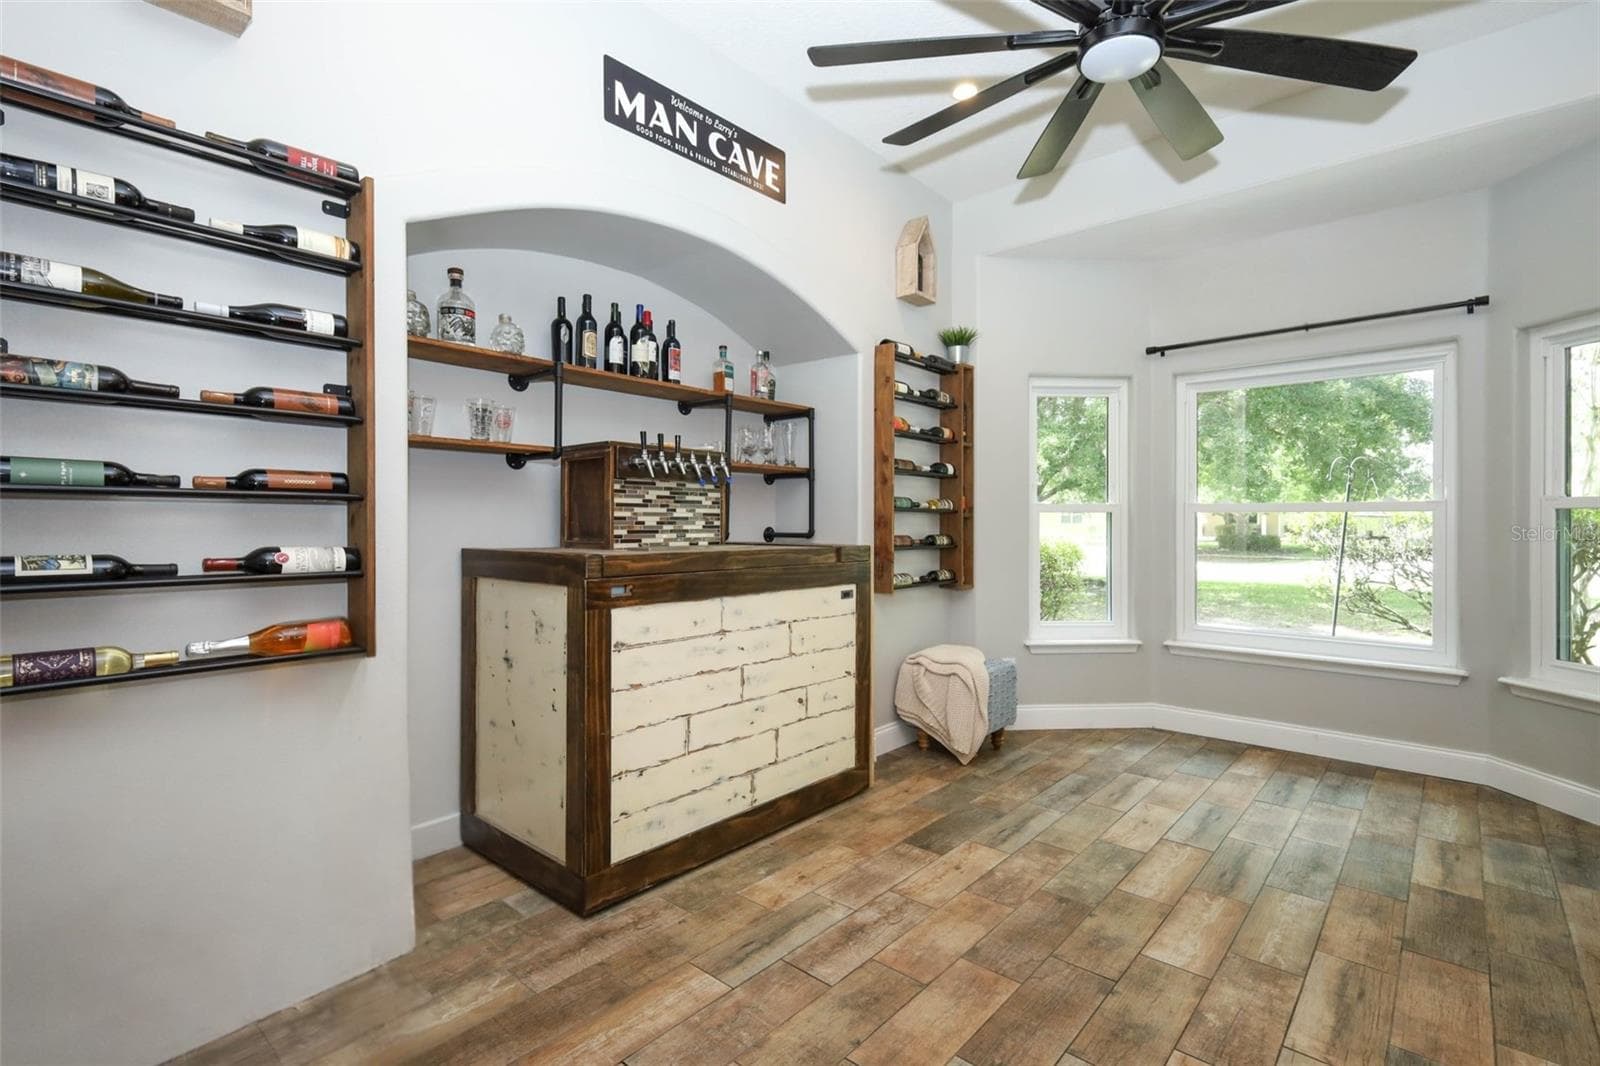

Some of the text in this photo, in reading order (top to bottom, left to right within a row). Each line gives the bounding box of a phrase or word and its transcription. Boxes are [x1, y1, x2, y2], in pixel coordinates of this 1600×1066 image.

[614, 79, 780, 192] MAN CAVE
[670, 95, 704, 121] Welcome
[705, 115, 713, 126] to
[636, 124, 654, 138] GOOD
[655, 133, 674, 149] FOOD,
[675, 143, 688, 155] BEER
[695, 153, 717, 168] FRIENDS
[721, 165, 753, 185] ESTABLISHED
